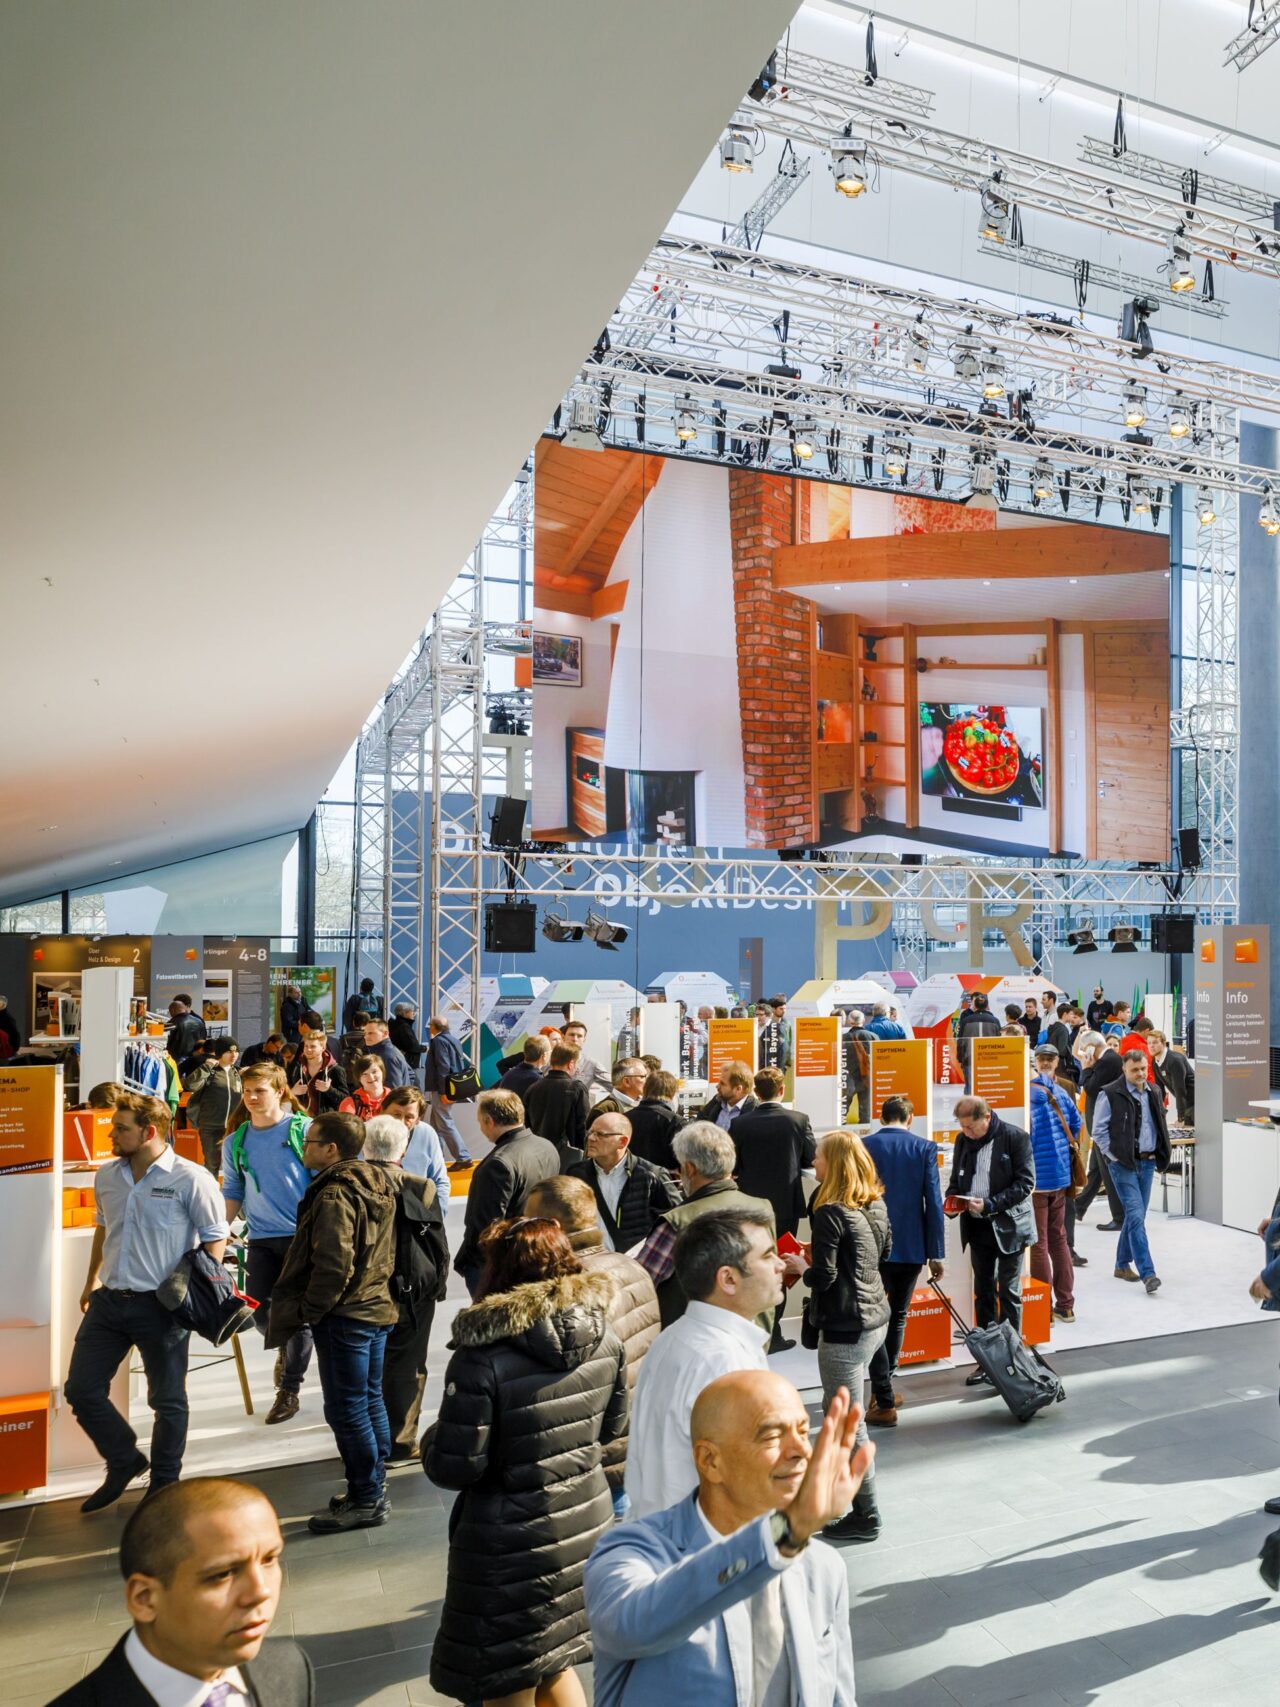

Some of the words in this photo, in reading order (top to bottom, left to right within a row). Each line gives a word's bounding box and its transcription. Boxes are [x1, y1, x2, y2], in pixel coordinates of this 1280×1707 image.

[133, 948, 141, 963] 2
[238, 947, 268, 962] 4-8
[1226, 991, 1249, 1004] Info
[941, 1044, 952, 1084] Bayern
[1020, 1293, 1044, 1303] reiner
[906, 1306, 944, 1318] chreiner
[899, 1349, 925, 1359] Bayern
